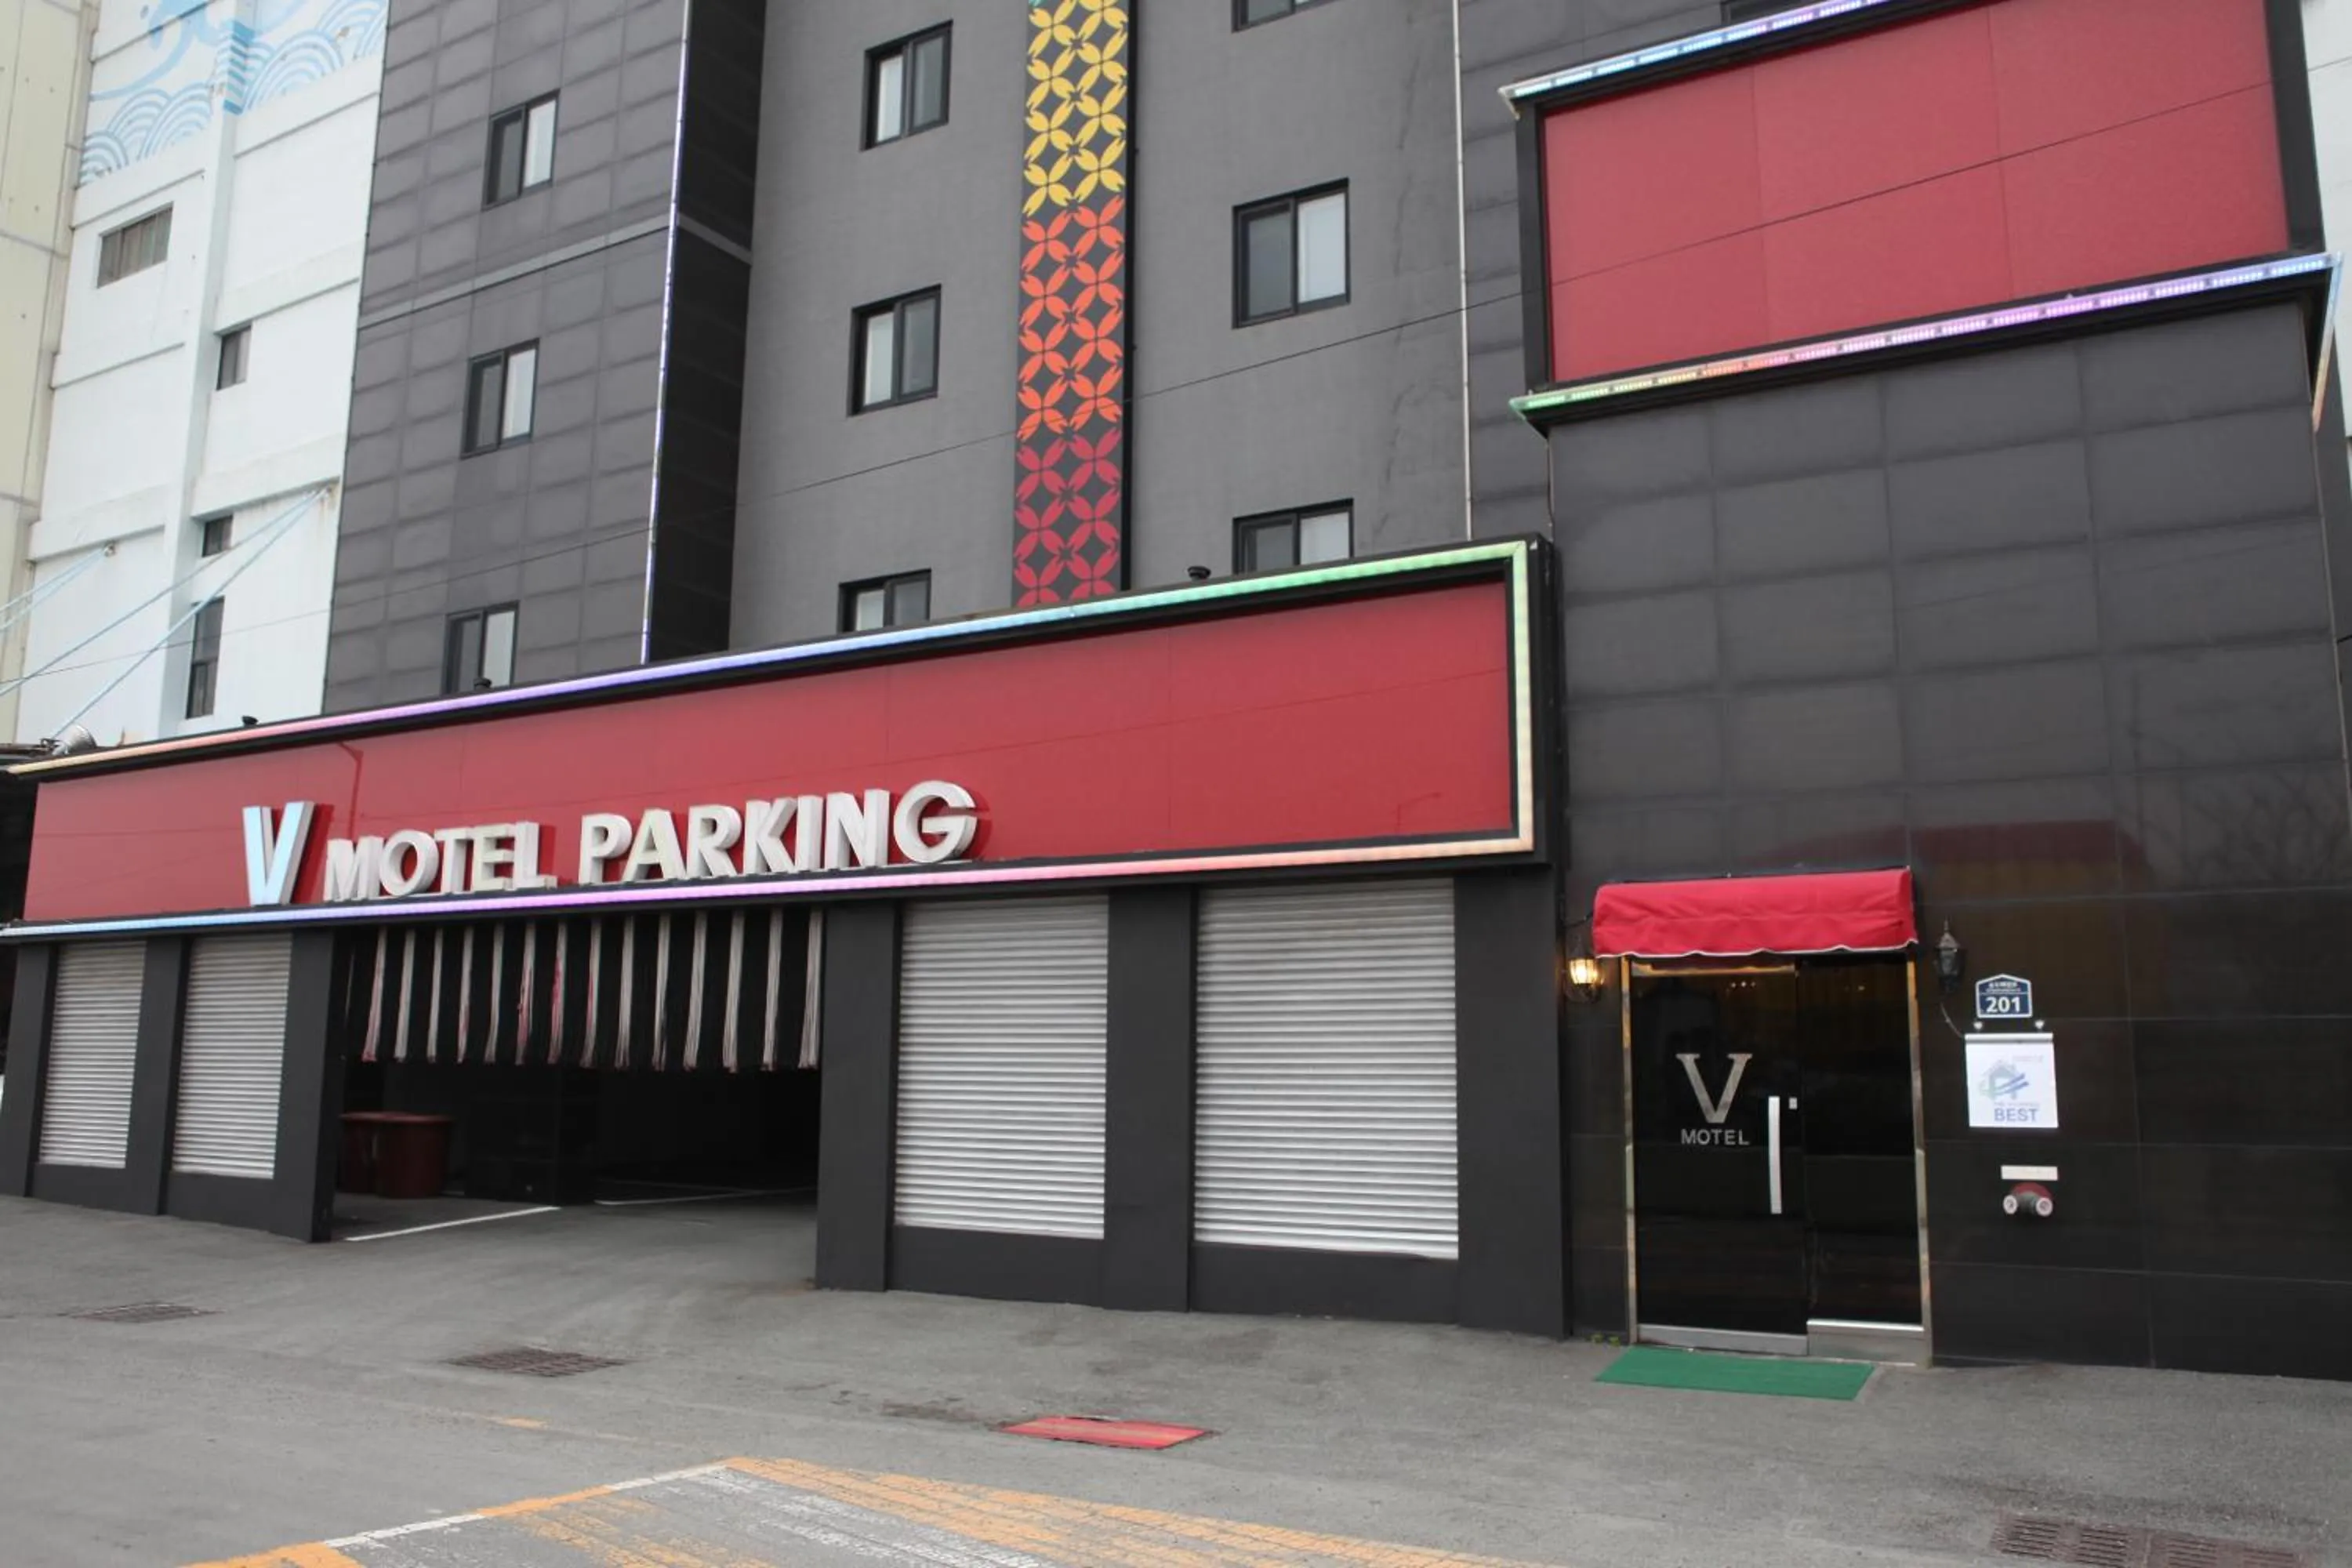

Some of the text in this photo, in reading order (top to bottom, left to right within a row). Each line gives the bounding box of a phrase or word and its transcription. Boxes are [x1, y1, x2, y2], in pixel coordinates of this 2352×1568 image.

[241, 779, 978, 906] V MOTEL PARKING
[1986, 996, 2020, 1013] 201
[1675, 1053, 1753, 1123] V
[1994, 1107, 2038, 1122] BEST
[1680, 1128, 1750, 1145] MOTEL
